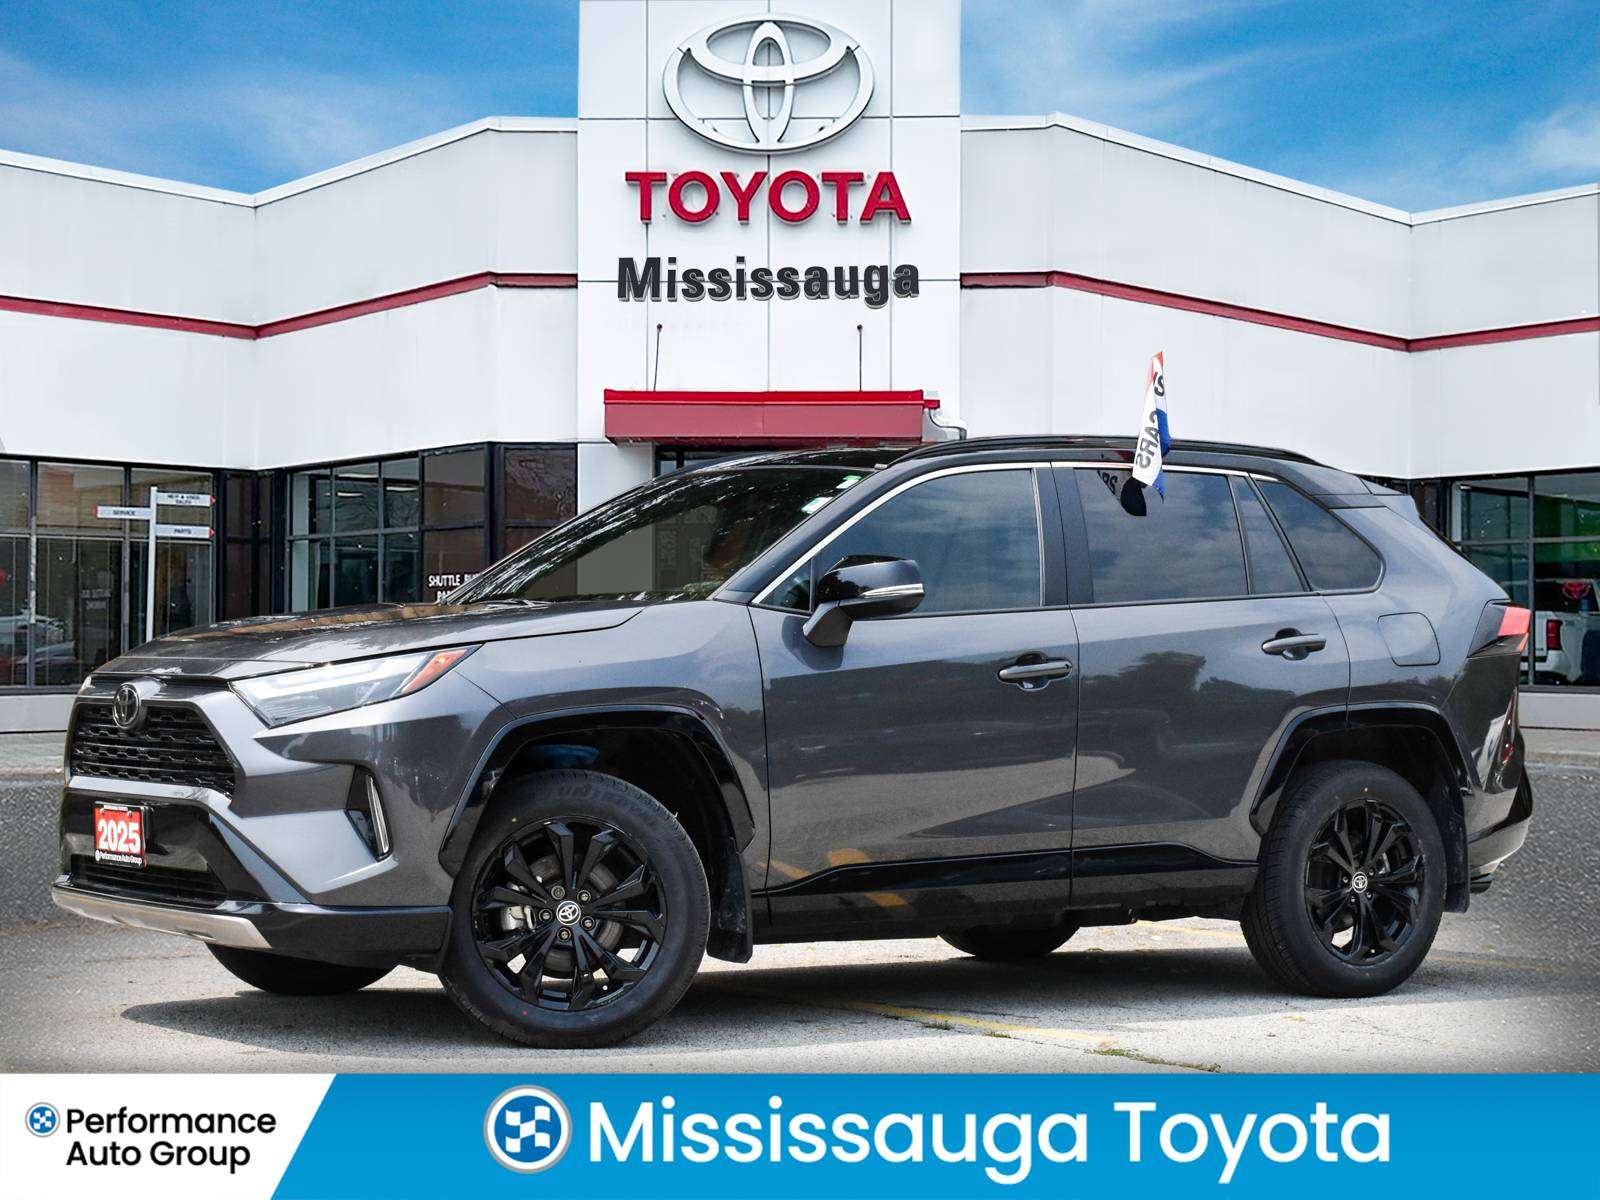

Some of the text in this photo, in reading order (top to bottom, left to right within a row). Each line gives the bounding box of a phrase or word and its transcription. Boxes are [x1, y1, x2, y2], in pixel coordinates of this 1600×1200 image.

[625, 170, 912, 225] TOYOTA
[617, 255, 920, 309] Mississauga
[428, 574, 461, 588] SHUTTLE
[98, 818, 141, 854] 2025
